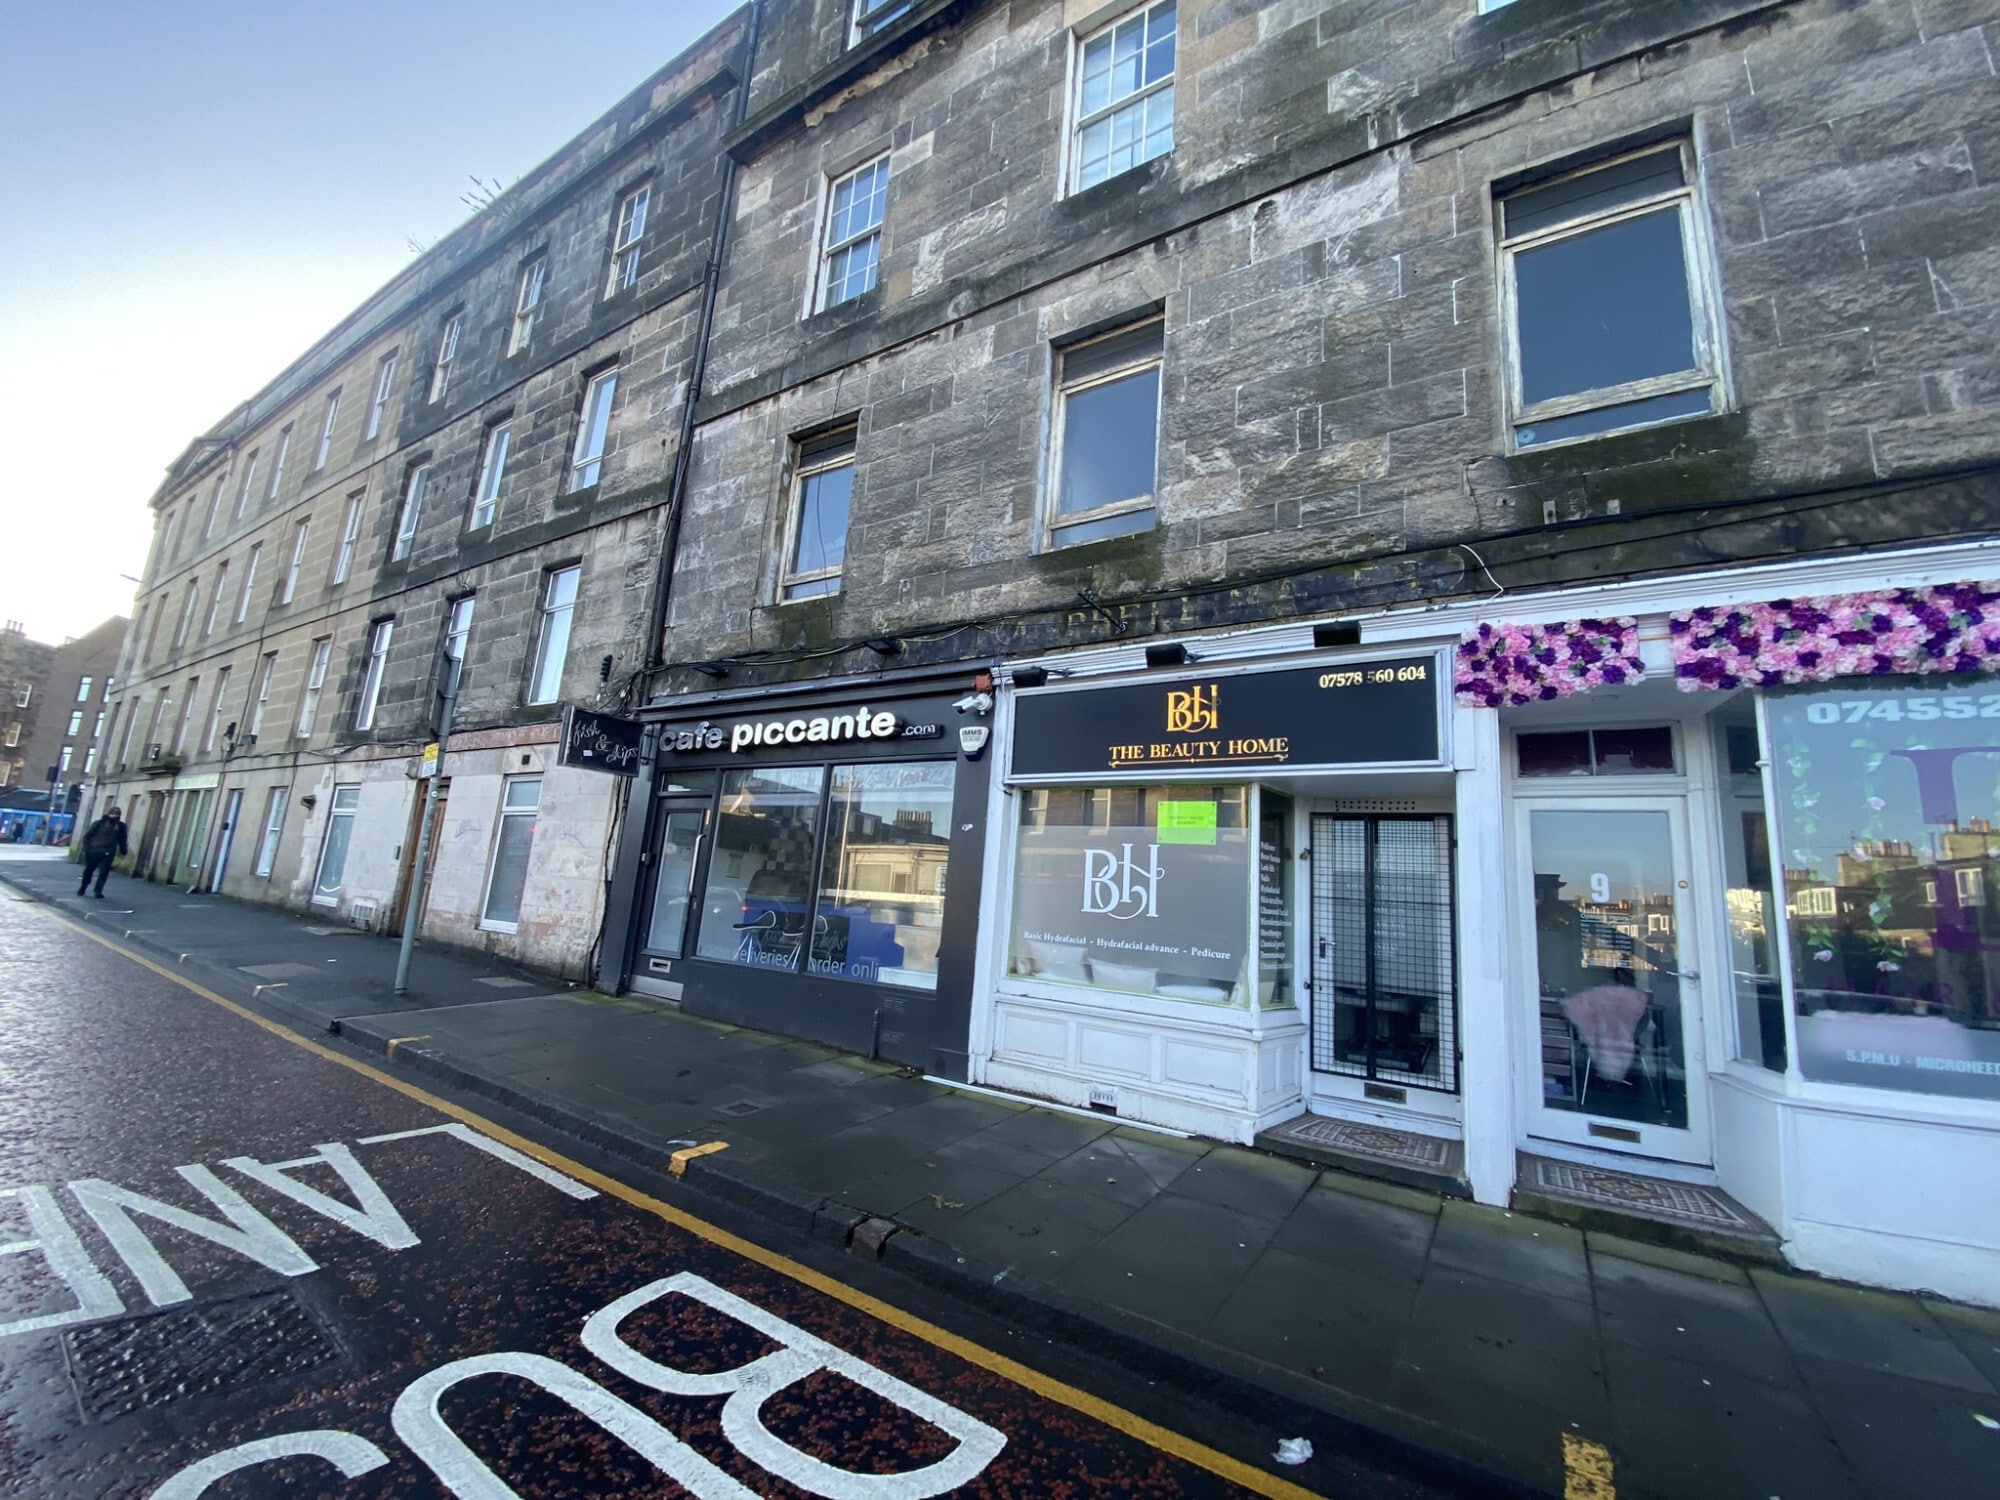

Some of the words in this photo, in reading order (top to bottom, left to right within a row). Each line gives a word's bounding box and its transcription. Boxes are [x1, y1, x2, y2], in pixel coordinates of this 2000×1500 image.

[1319, 671, 1363, 688] 07578
[1367, 667, 1395, 684] 560
[1397, 665, 1426, 682] 604
[573, 720, 601, 747] fish
[659, 721, 723, 752] cafe
[731, 706, 896, 753] piccante
[595, 734, 612, 752] &
[1108, 745, 1144, 760] THE
[1150, 741, 1221, 759] BEAUTY
[1228, 737, 1289, 755] HOME
[606, 744, 640, 768] chips
[1591, 873, 1610, 903] 9
[1024, 931, 1042, 941] Basic
[1043, 932, 1086, 945] Hydrafacial
[1096, 937, 1143, 951] Hydrafacial
[1145, 943, 1179, 955] advance
[1191, 947, 1231, 960] Pedicure
